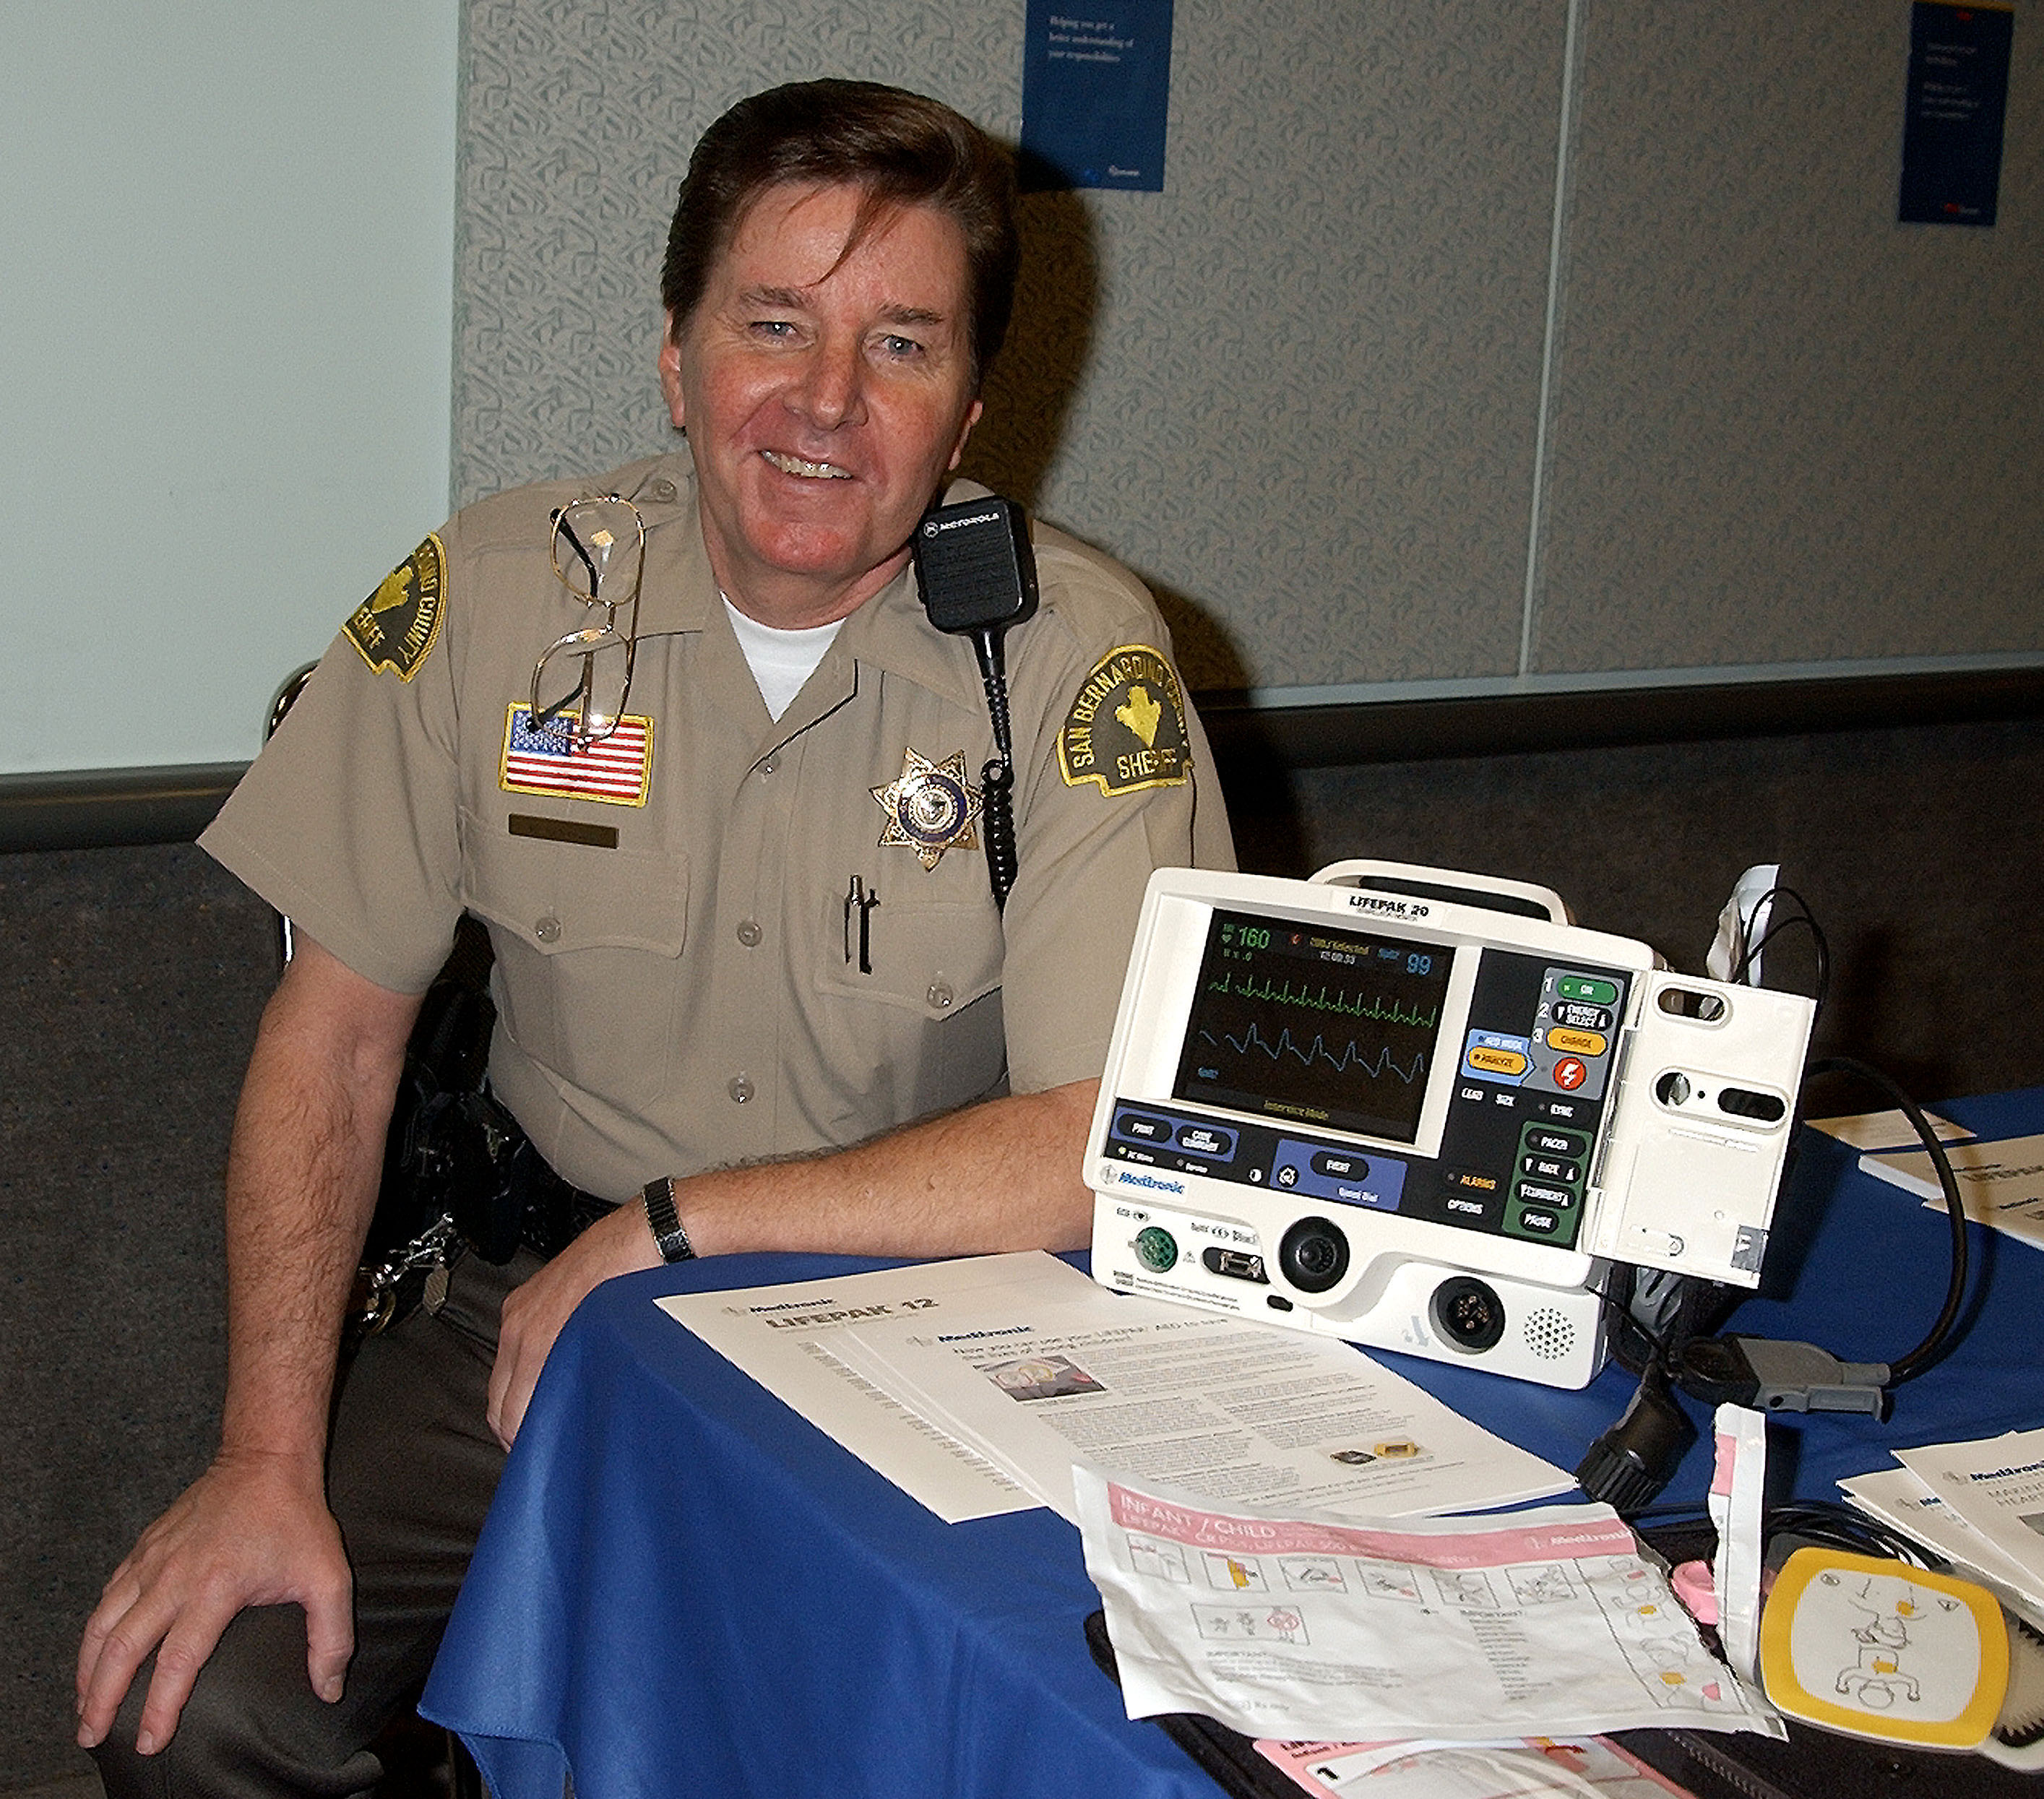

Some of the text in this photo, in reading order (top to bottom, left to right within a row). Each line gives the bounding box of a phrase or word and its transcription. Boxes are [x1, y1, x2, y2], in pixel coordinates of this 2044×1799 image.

[940, 512, 1000, 531] MOTOROLA
[397, 595, 436, 664] COUNTY
[1068, 655, 1165, 769] SAN BERNARDINO
[1349, 895, 1407, 914] LIFEPAK
[1410, 905, 1429, 917] 20
[1238, 926, 1270, 950] 160
[1406, 952, 1432, 975] 99
[1543, 978, 1555, 993] 1
[1538, 1002, 1551, 1019] 2
[1532, 1027, 1545, 1043] 3
[1118, 1171, 1186, 1194] Medtronic
[1459, 1175, 1497, 1191] ALARMS
[749, 1298, 835, 1313] Medtronic
[764, 1303, 894, 1328] LIFEPAK
[901, 1298, 940, 1311] 12
[937, 1325, 1035, 1343] Medtronic
[1120, 1493, 1192, 1526] INFANT
[1215, 1519, 1277, 1539] CHILD
